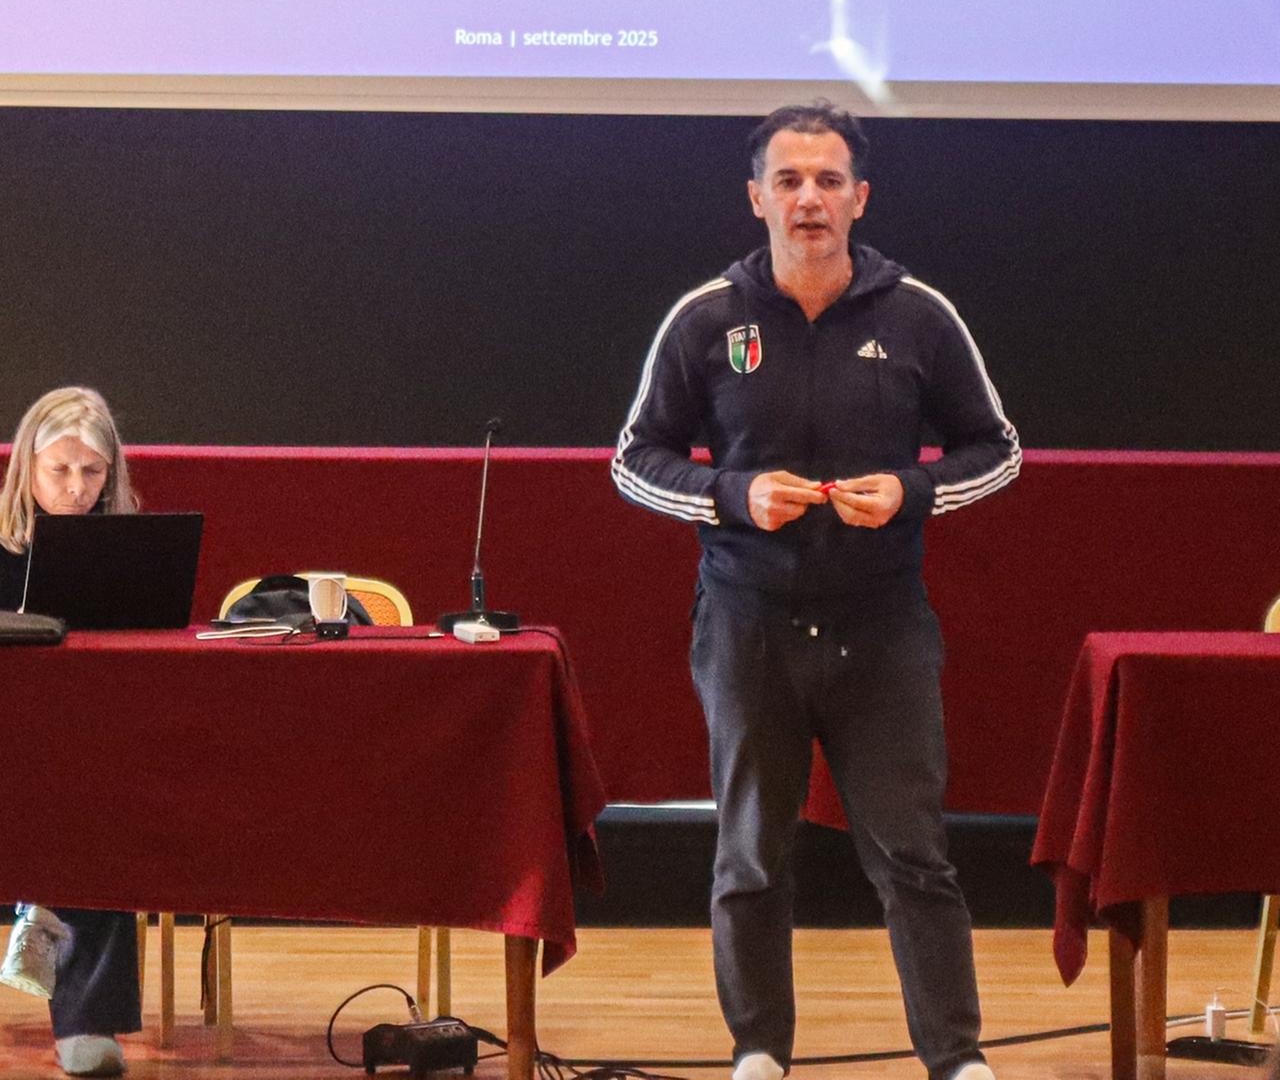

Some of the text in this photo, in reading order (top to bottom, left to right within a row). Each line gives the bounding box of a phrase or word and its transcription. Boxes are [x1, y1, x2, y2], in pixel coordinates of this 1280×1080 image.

[455, 29, 502, 45] Roma
[523, 30, 612, 46] settembre
[618, 30, 658, 46] 2025
